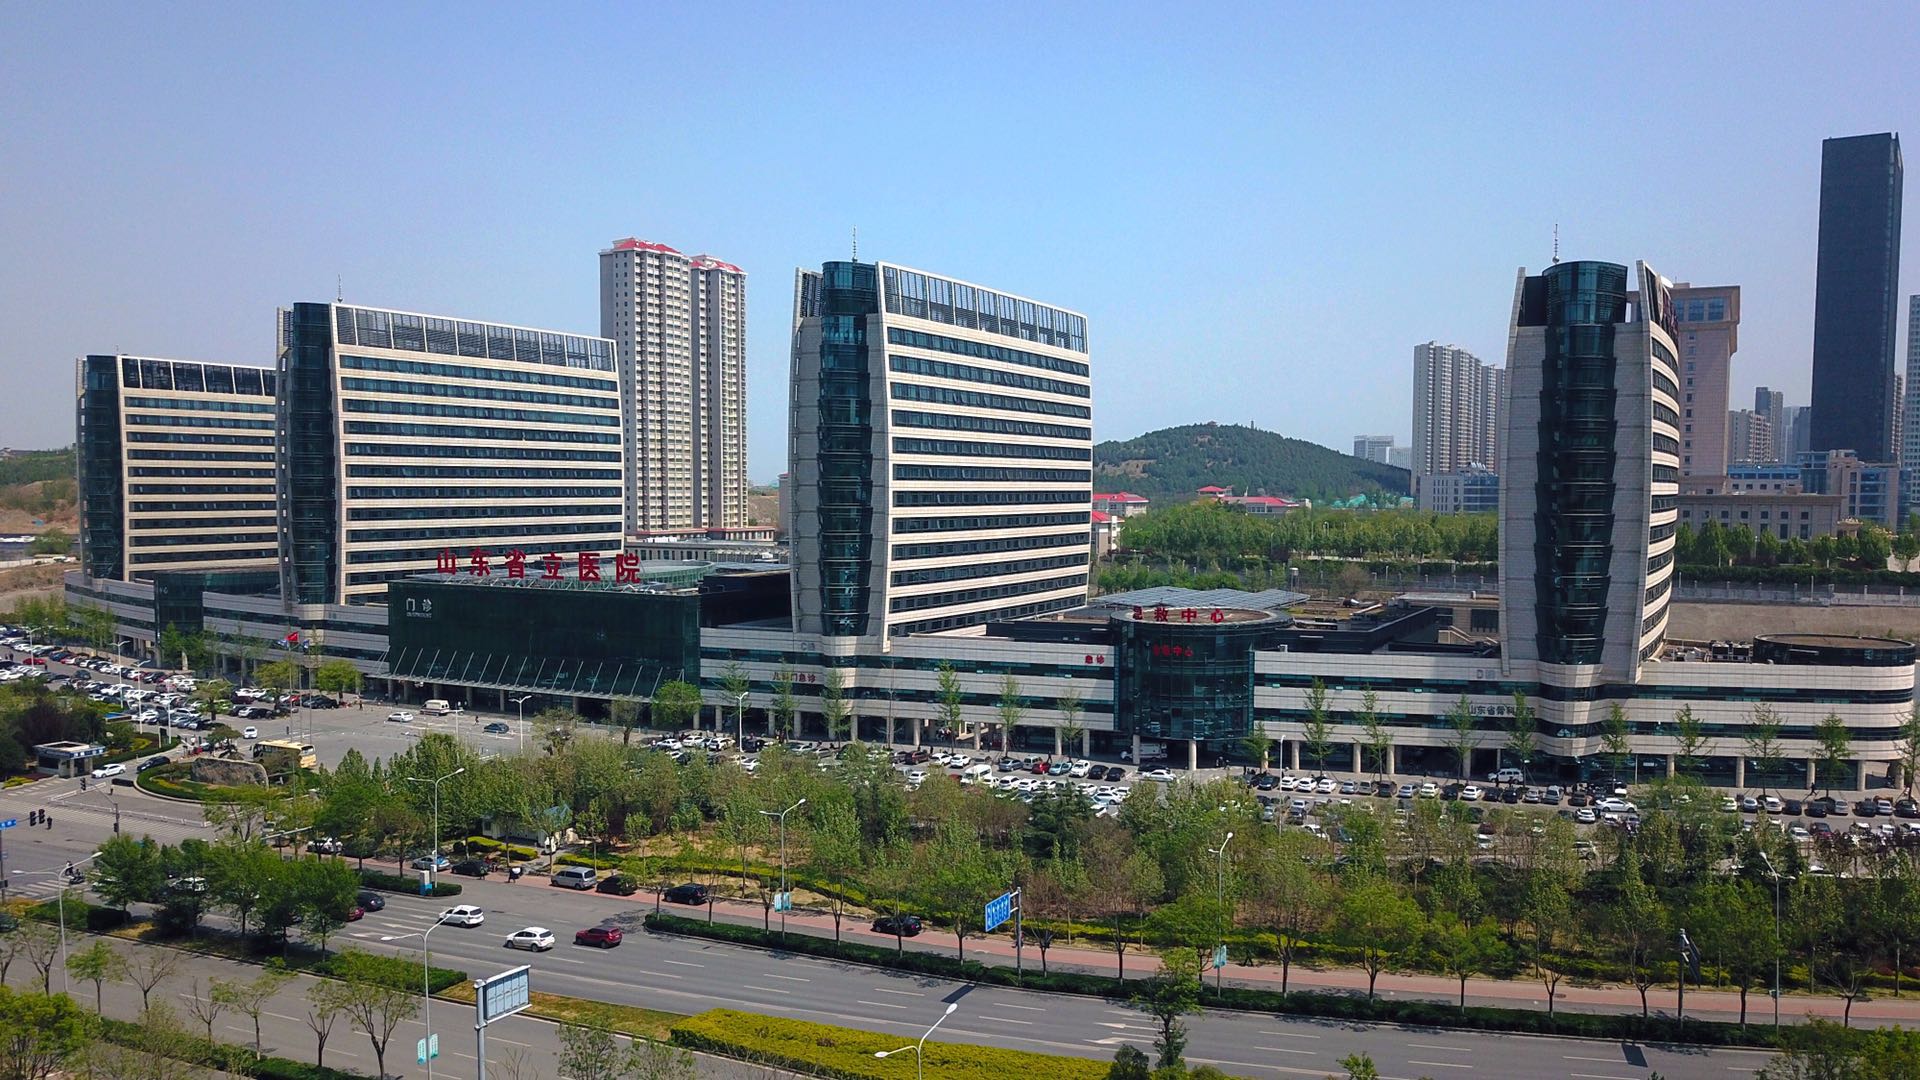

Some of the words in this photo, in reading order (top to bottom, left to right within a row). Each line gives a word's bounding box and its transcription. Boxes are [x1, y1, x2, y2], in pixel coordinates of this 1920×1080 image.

[436, 547, 641, 583] 山东省立医院
[406, 598, 432, 612] 门诊
[1132, 605, 1224, 623] 急救中心
